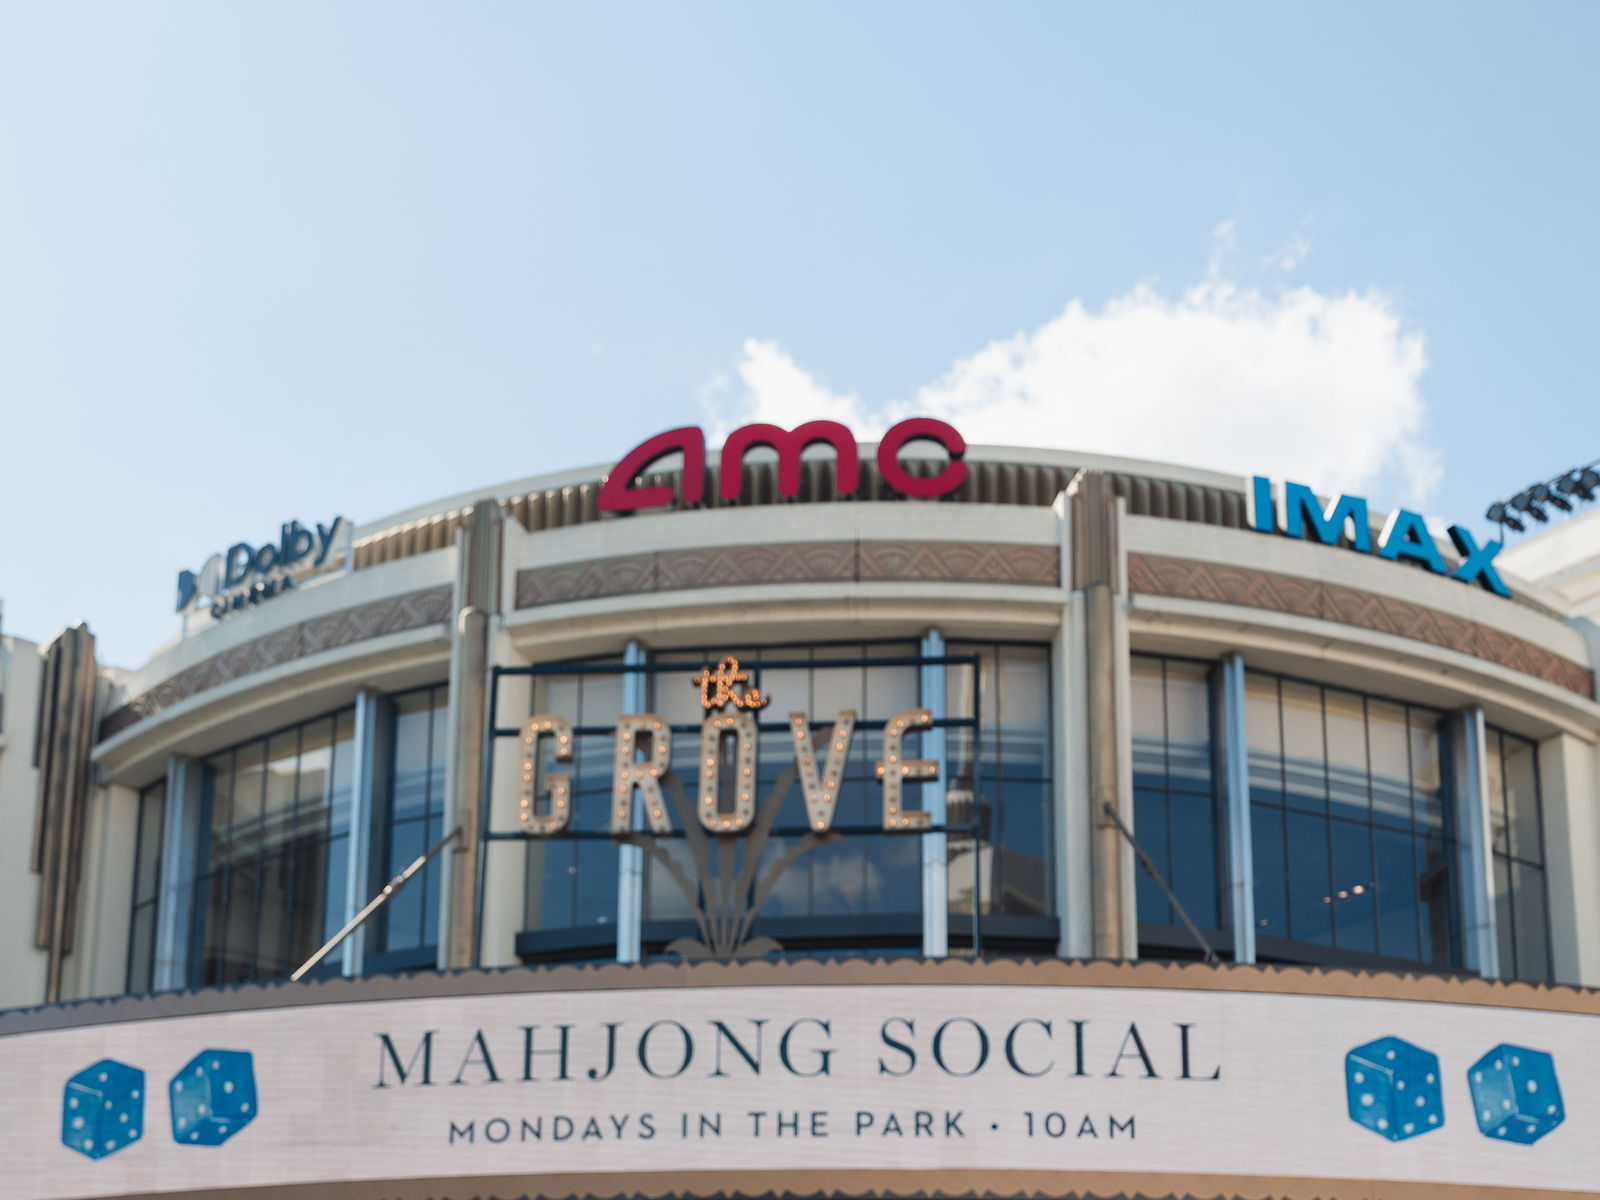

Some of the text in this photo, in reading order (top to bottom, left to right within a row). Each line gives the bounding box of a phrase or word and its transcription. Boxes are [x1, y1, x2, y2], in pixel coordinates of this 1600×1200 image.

[224, 515, 344, 589] Dolby
[1248, 475, 1512, 598] IMAX
[692, 656, 770, 709] the
[519, 708, 938, 834] GROVE
[372, 1016, 1221, 1089] MAHJONG SOCIAL
[448, 1113, 657, 1146] MONDAYS
[682, 1112, 722, 1138] IN
[749, 1111, 829, 1138] THE
[855, 1110, 965, 1138] PARK
[1024, 1111, 1136, 1139] 10AM
